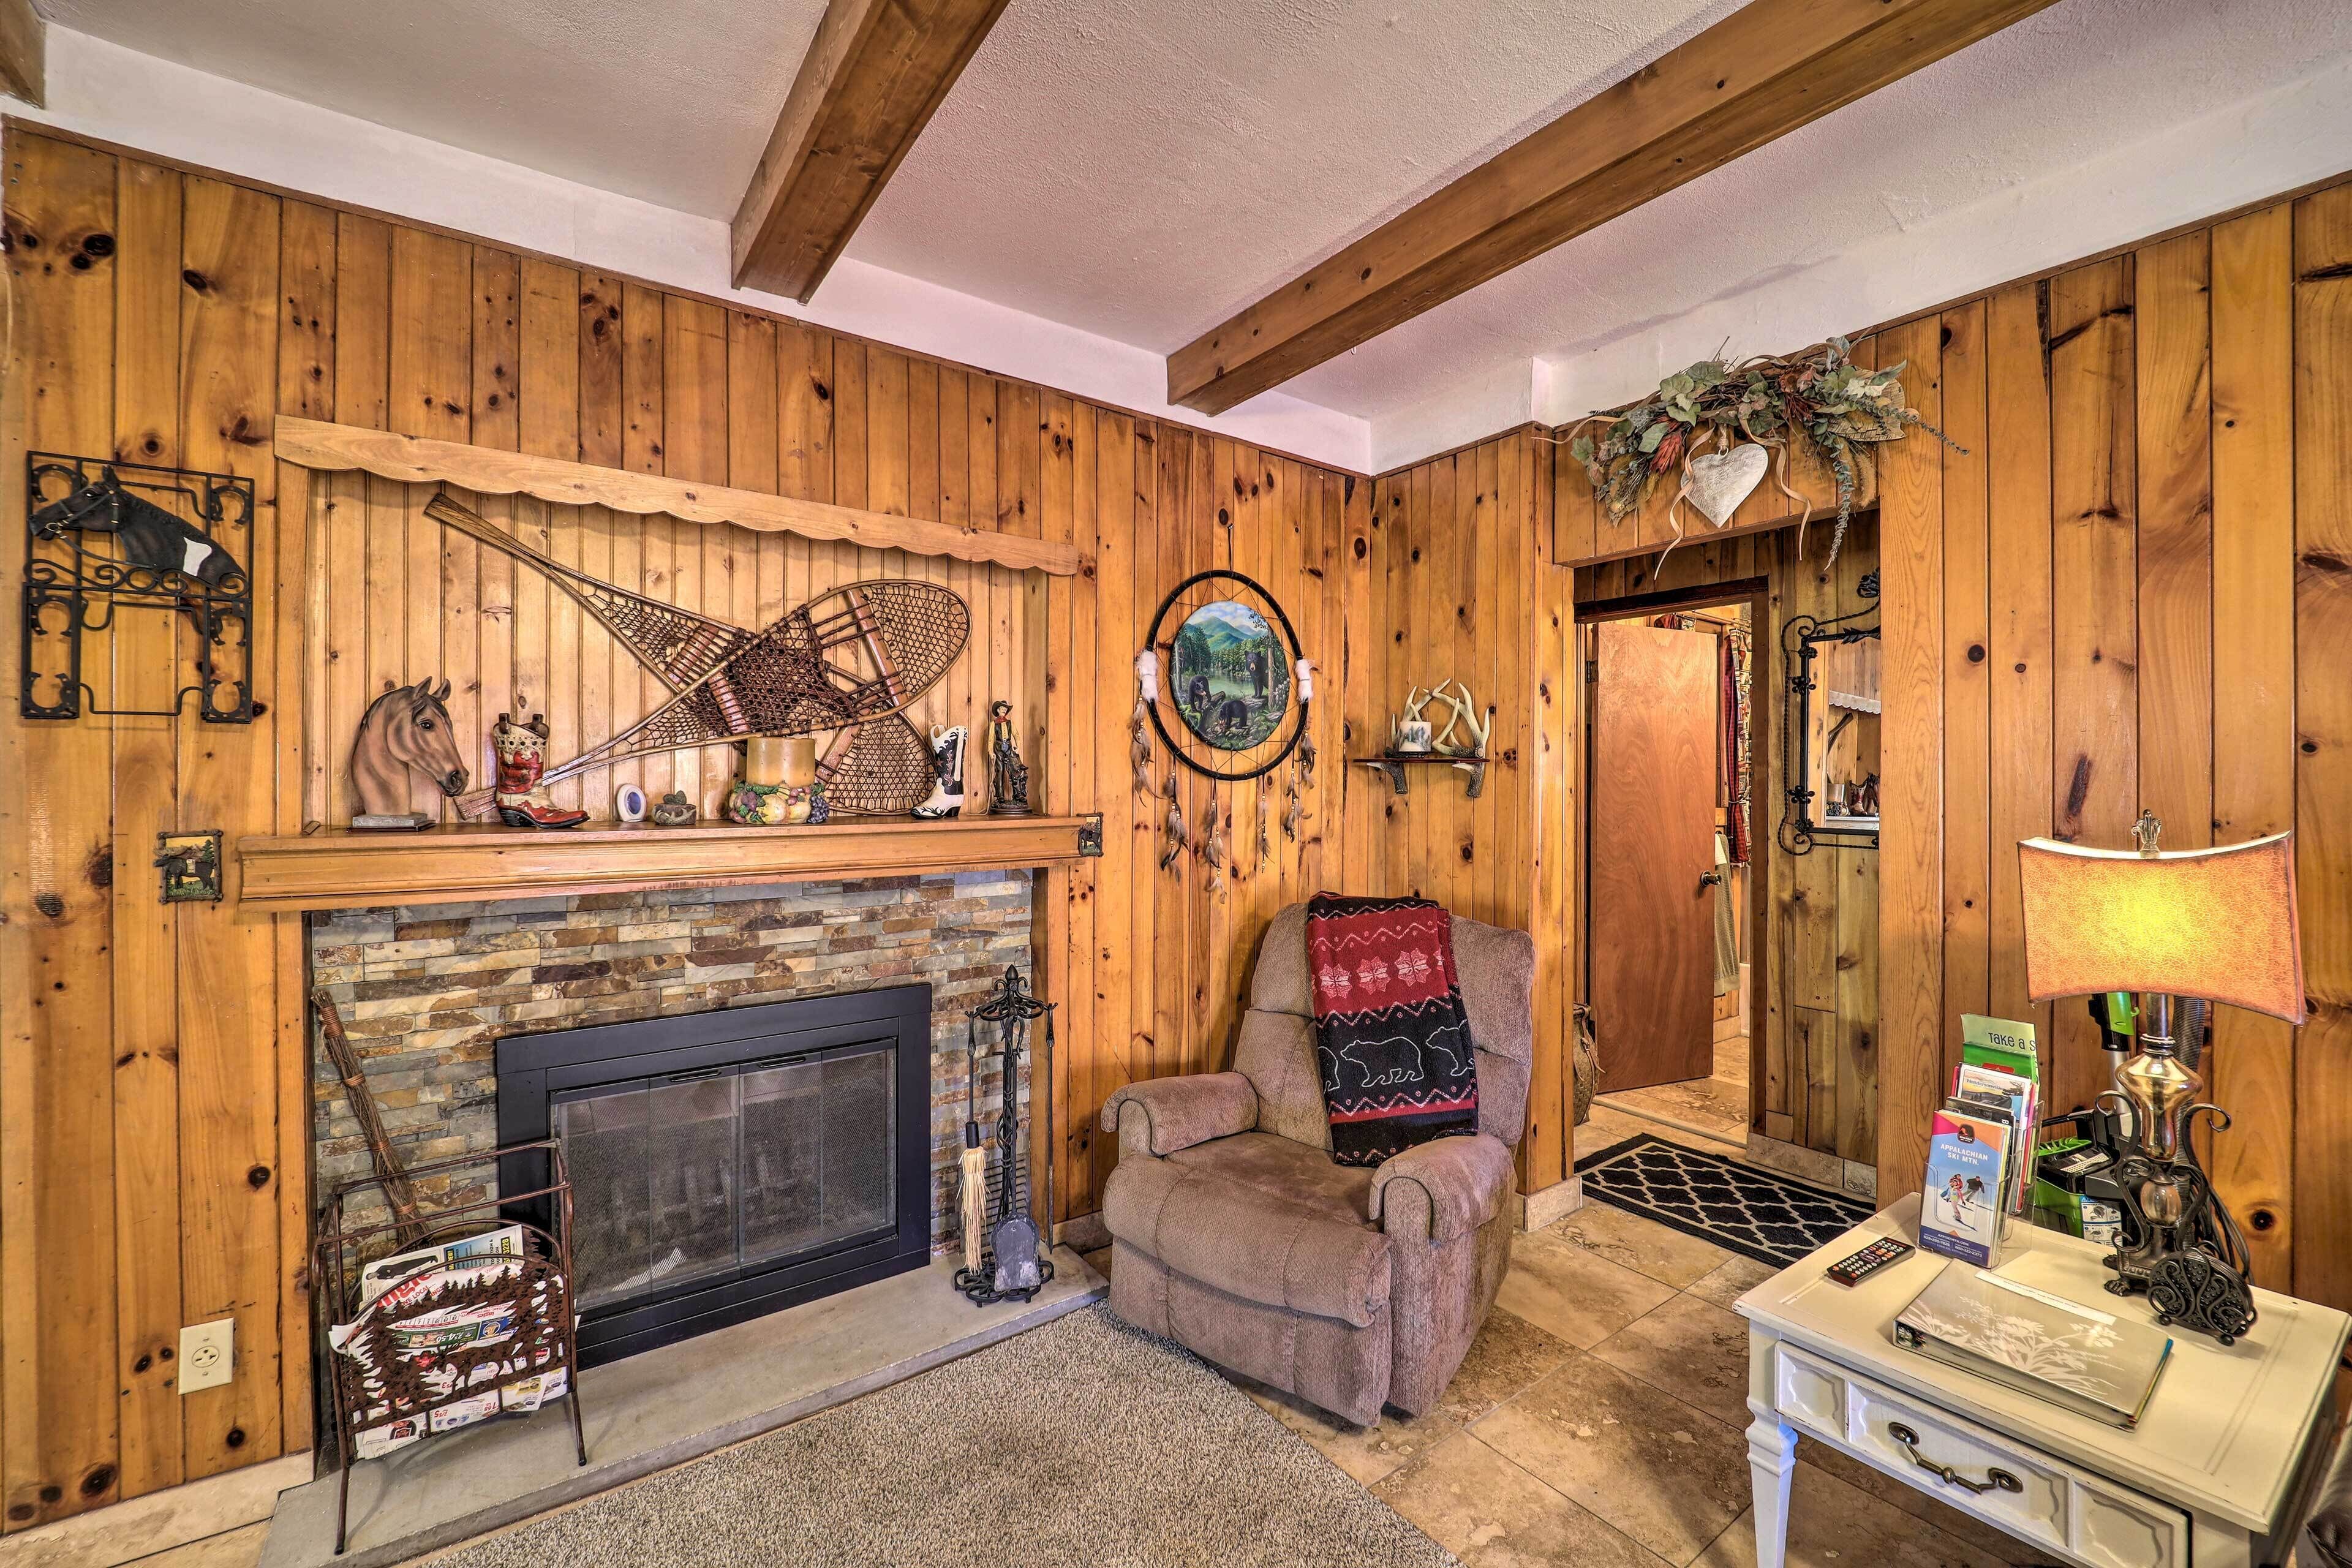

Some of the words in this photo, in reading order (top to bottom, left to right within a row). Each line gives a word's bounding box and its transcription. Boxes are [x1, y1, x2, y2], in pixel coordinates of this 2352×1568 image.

[1988, 1032, 2015, 1047] Take
[2018, 1038, 2026, 1049] a
[1940, 1144, 1988, 1161] APPALACHIAN
[1962, 1156, 1980, 1166] MTN.
